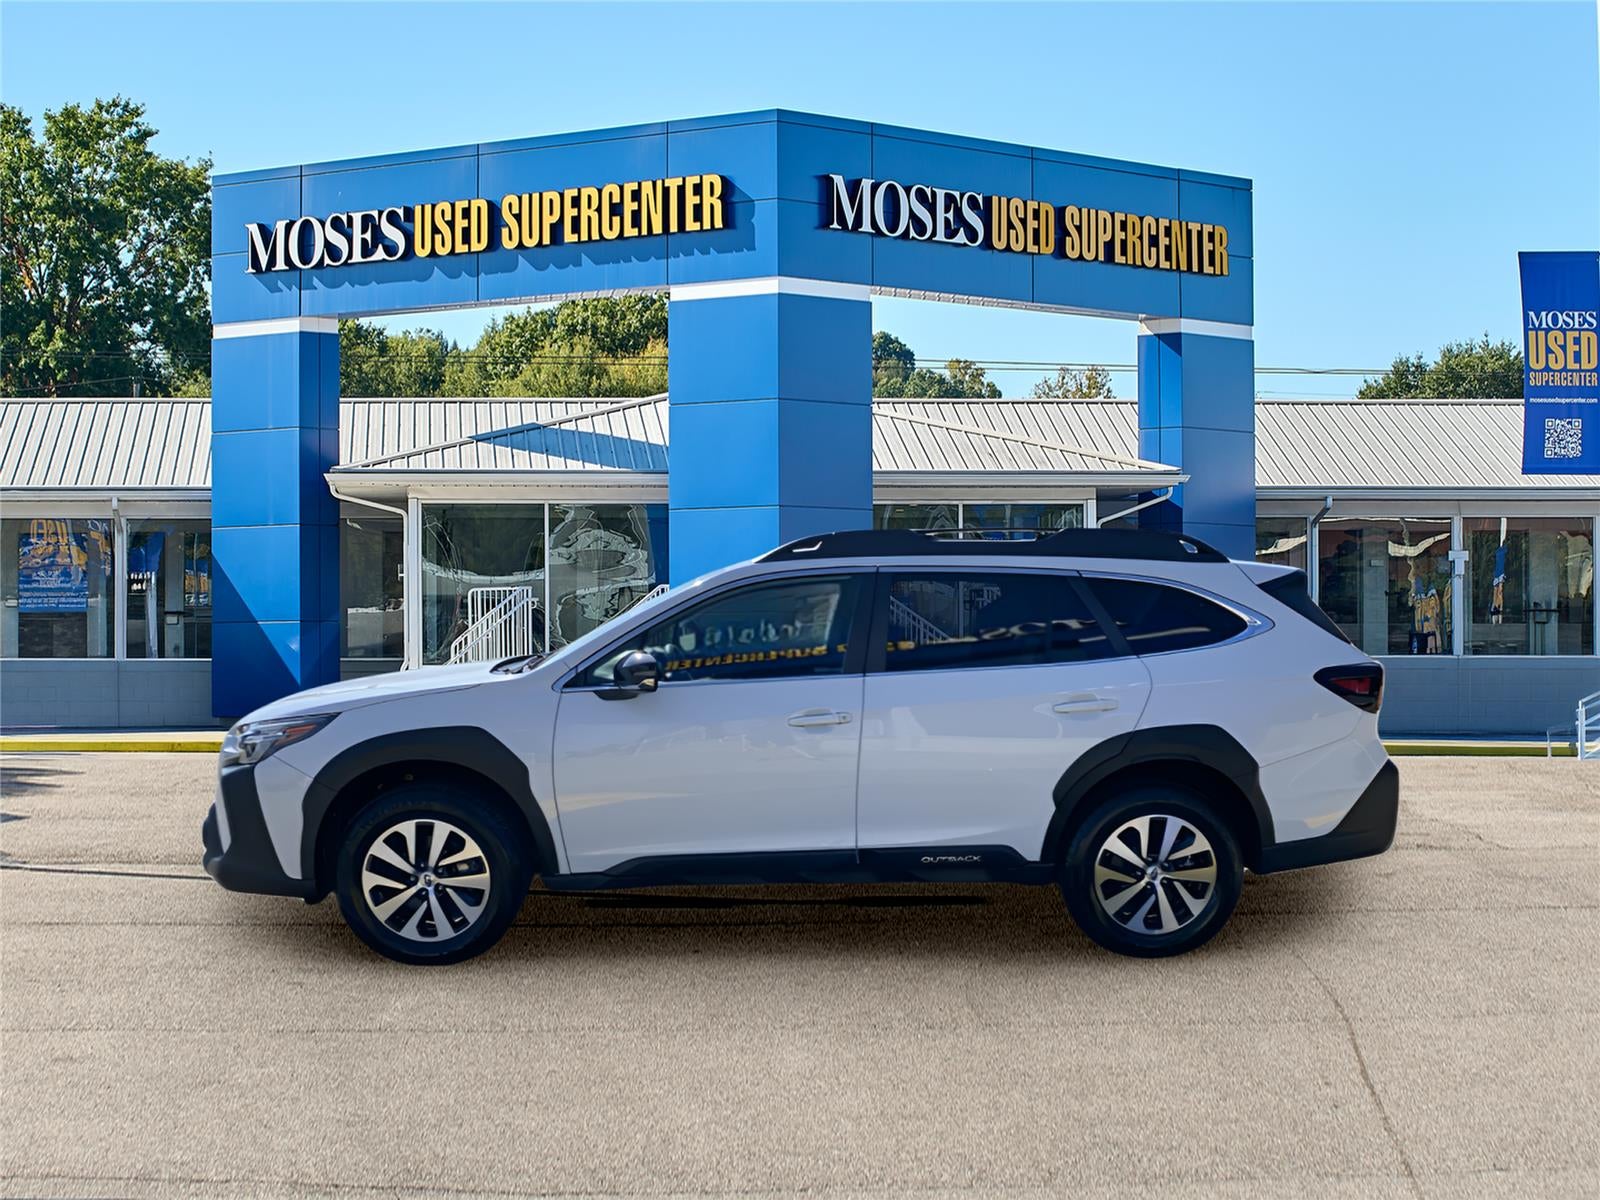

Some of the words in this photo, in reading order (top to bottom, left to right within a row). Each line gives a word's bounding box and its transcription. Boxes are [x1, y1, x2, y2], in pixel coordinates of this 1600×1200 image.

[244, 207, 407, 274] MOSES
[413, 198, 489, 258] USED
[500, 173, 724, 250] SUPERCENTER
[829, 174, 985, 247] MOSES
[990, 195, 1055, 255] USED
[1064, 205, 1229, 276] SUPERCENTER
[1528, 311, 1597, 329] MOSES
[1528, 330, 1598, 370] USED
[1529, 371, 1598, 387] SUPERCENTER
[1529, 396, 1599, 405] mosesusedsupercenter.com
[920, 855, 982, 864] OUTBACK
